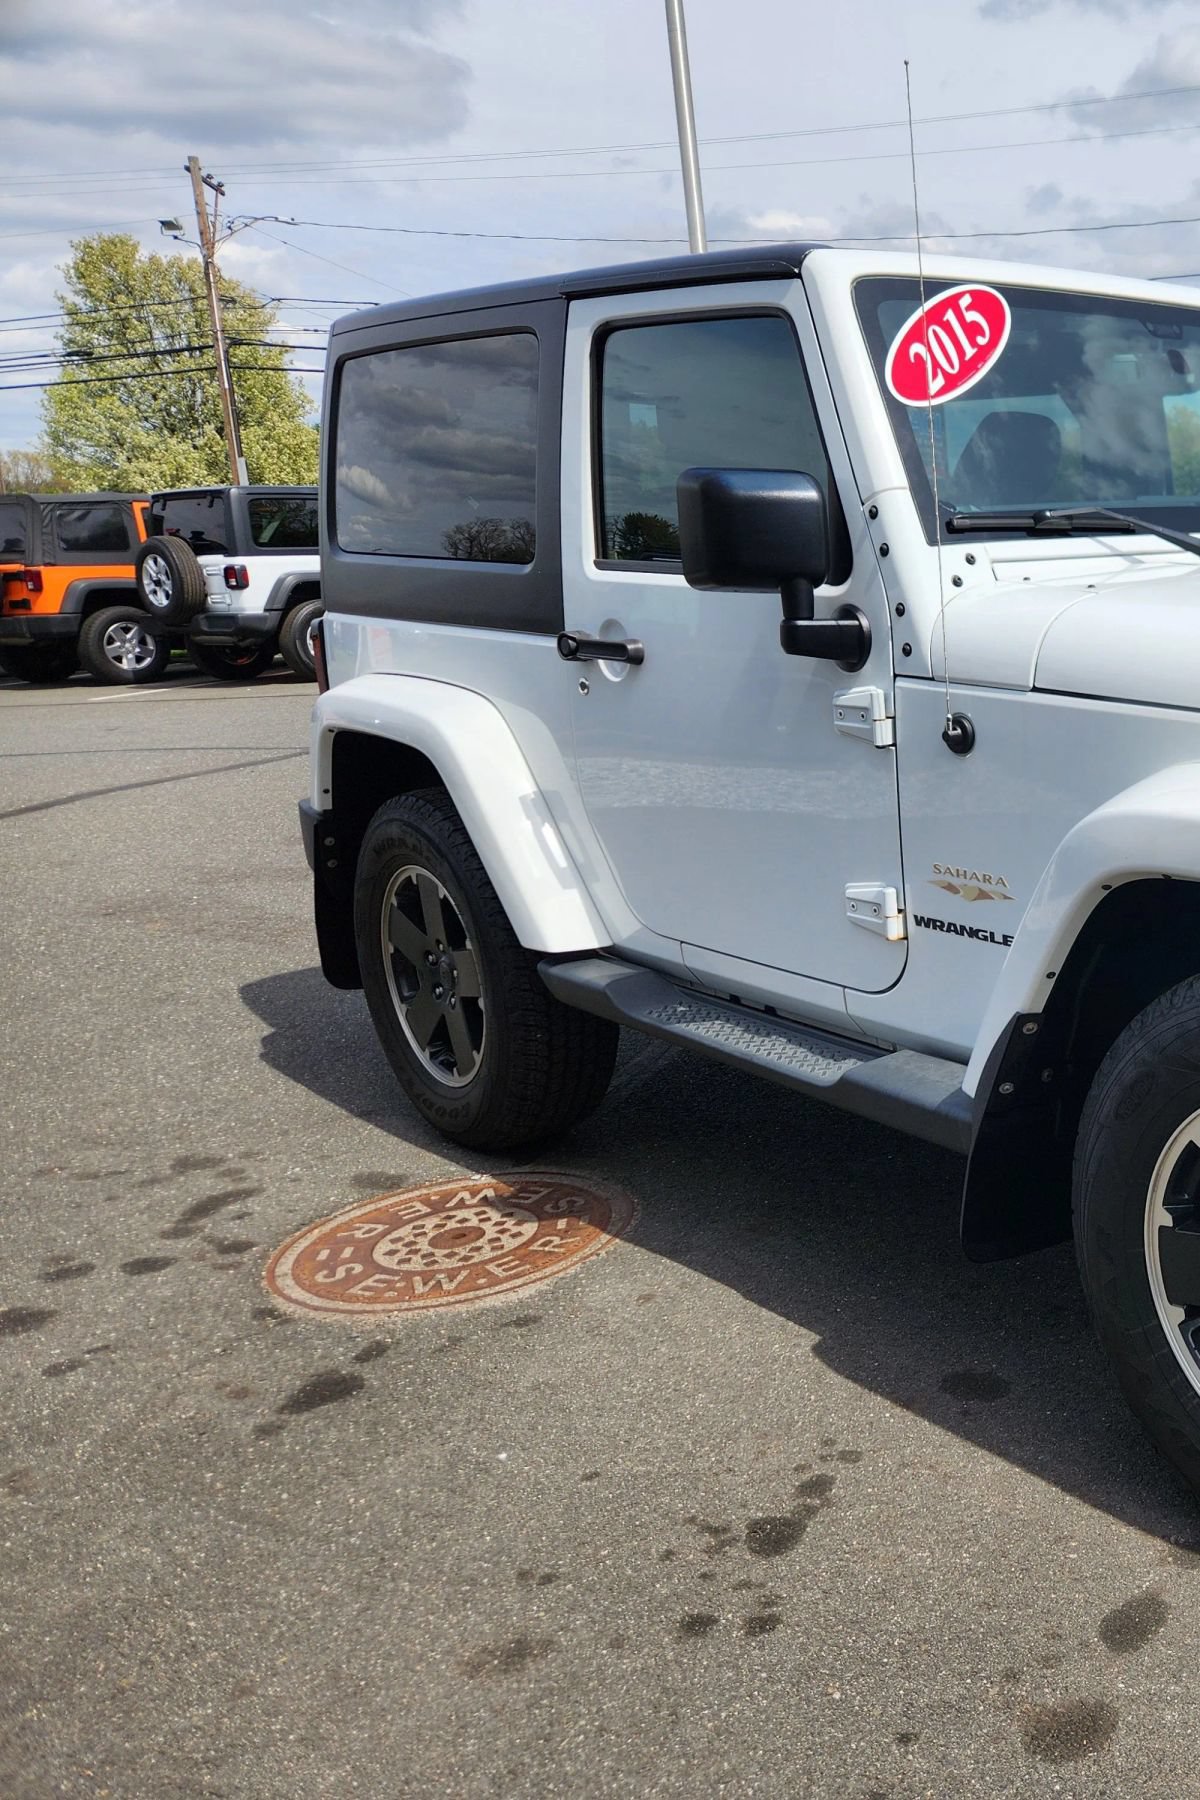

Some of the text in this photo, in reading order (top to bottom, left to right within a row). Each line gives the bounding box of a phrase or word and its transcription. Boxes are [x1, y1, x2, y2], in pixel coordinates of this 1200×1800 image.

[908, 293, 991, 396] 2015
[933, 862, 1009, 888] SAHARA
[314, 1236, 581, 1297] SEWER
